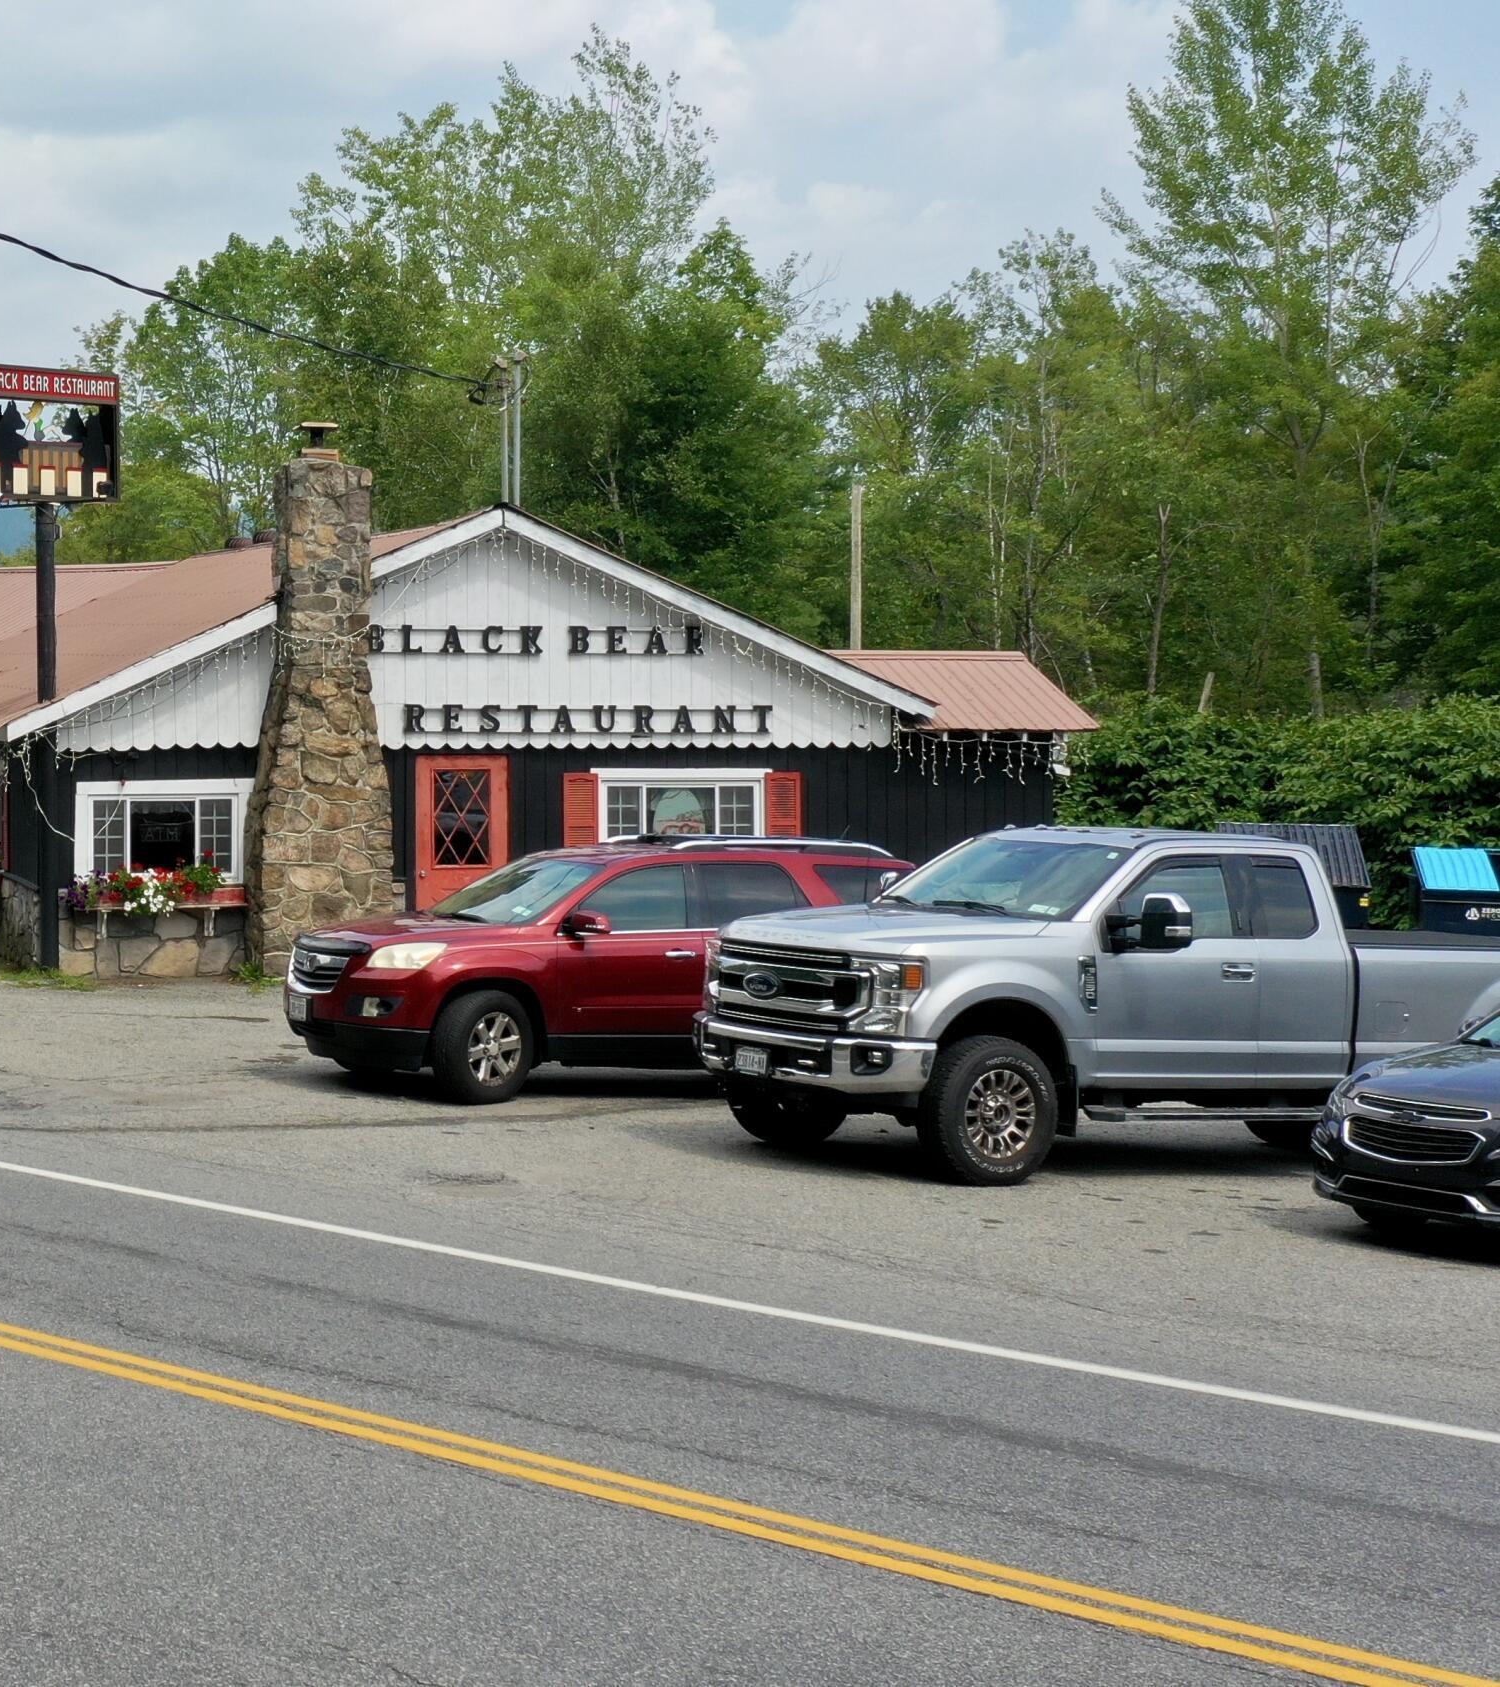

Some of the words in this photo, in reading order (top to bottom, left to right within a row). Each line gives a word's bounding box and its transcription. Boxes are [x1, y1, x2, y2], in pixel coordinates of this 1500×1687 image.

[23, 374, 49, 392] BEAR
[53, 376, 115, 397] RESTAURANT
[368, 624, 543, 655] BLACK
[567, 625, 704, 656] BEAR
[403, 704, 773, 734] RESTAURANT
